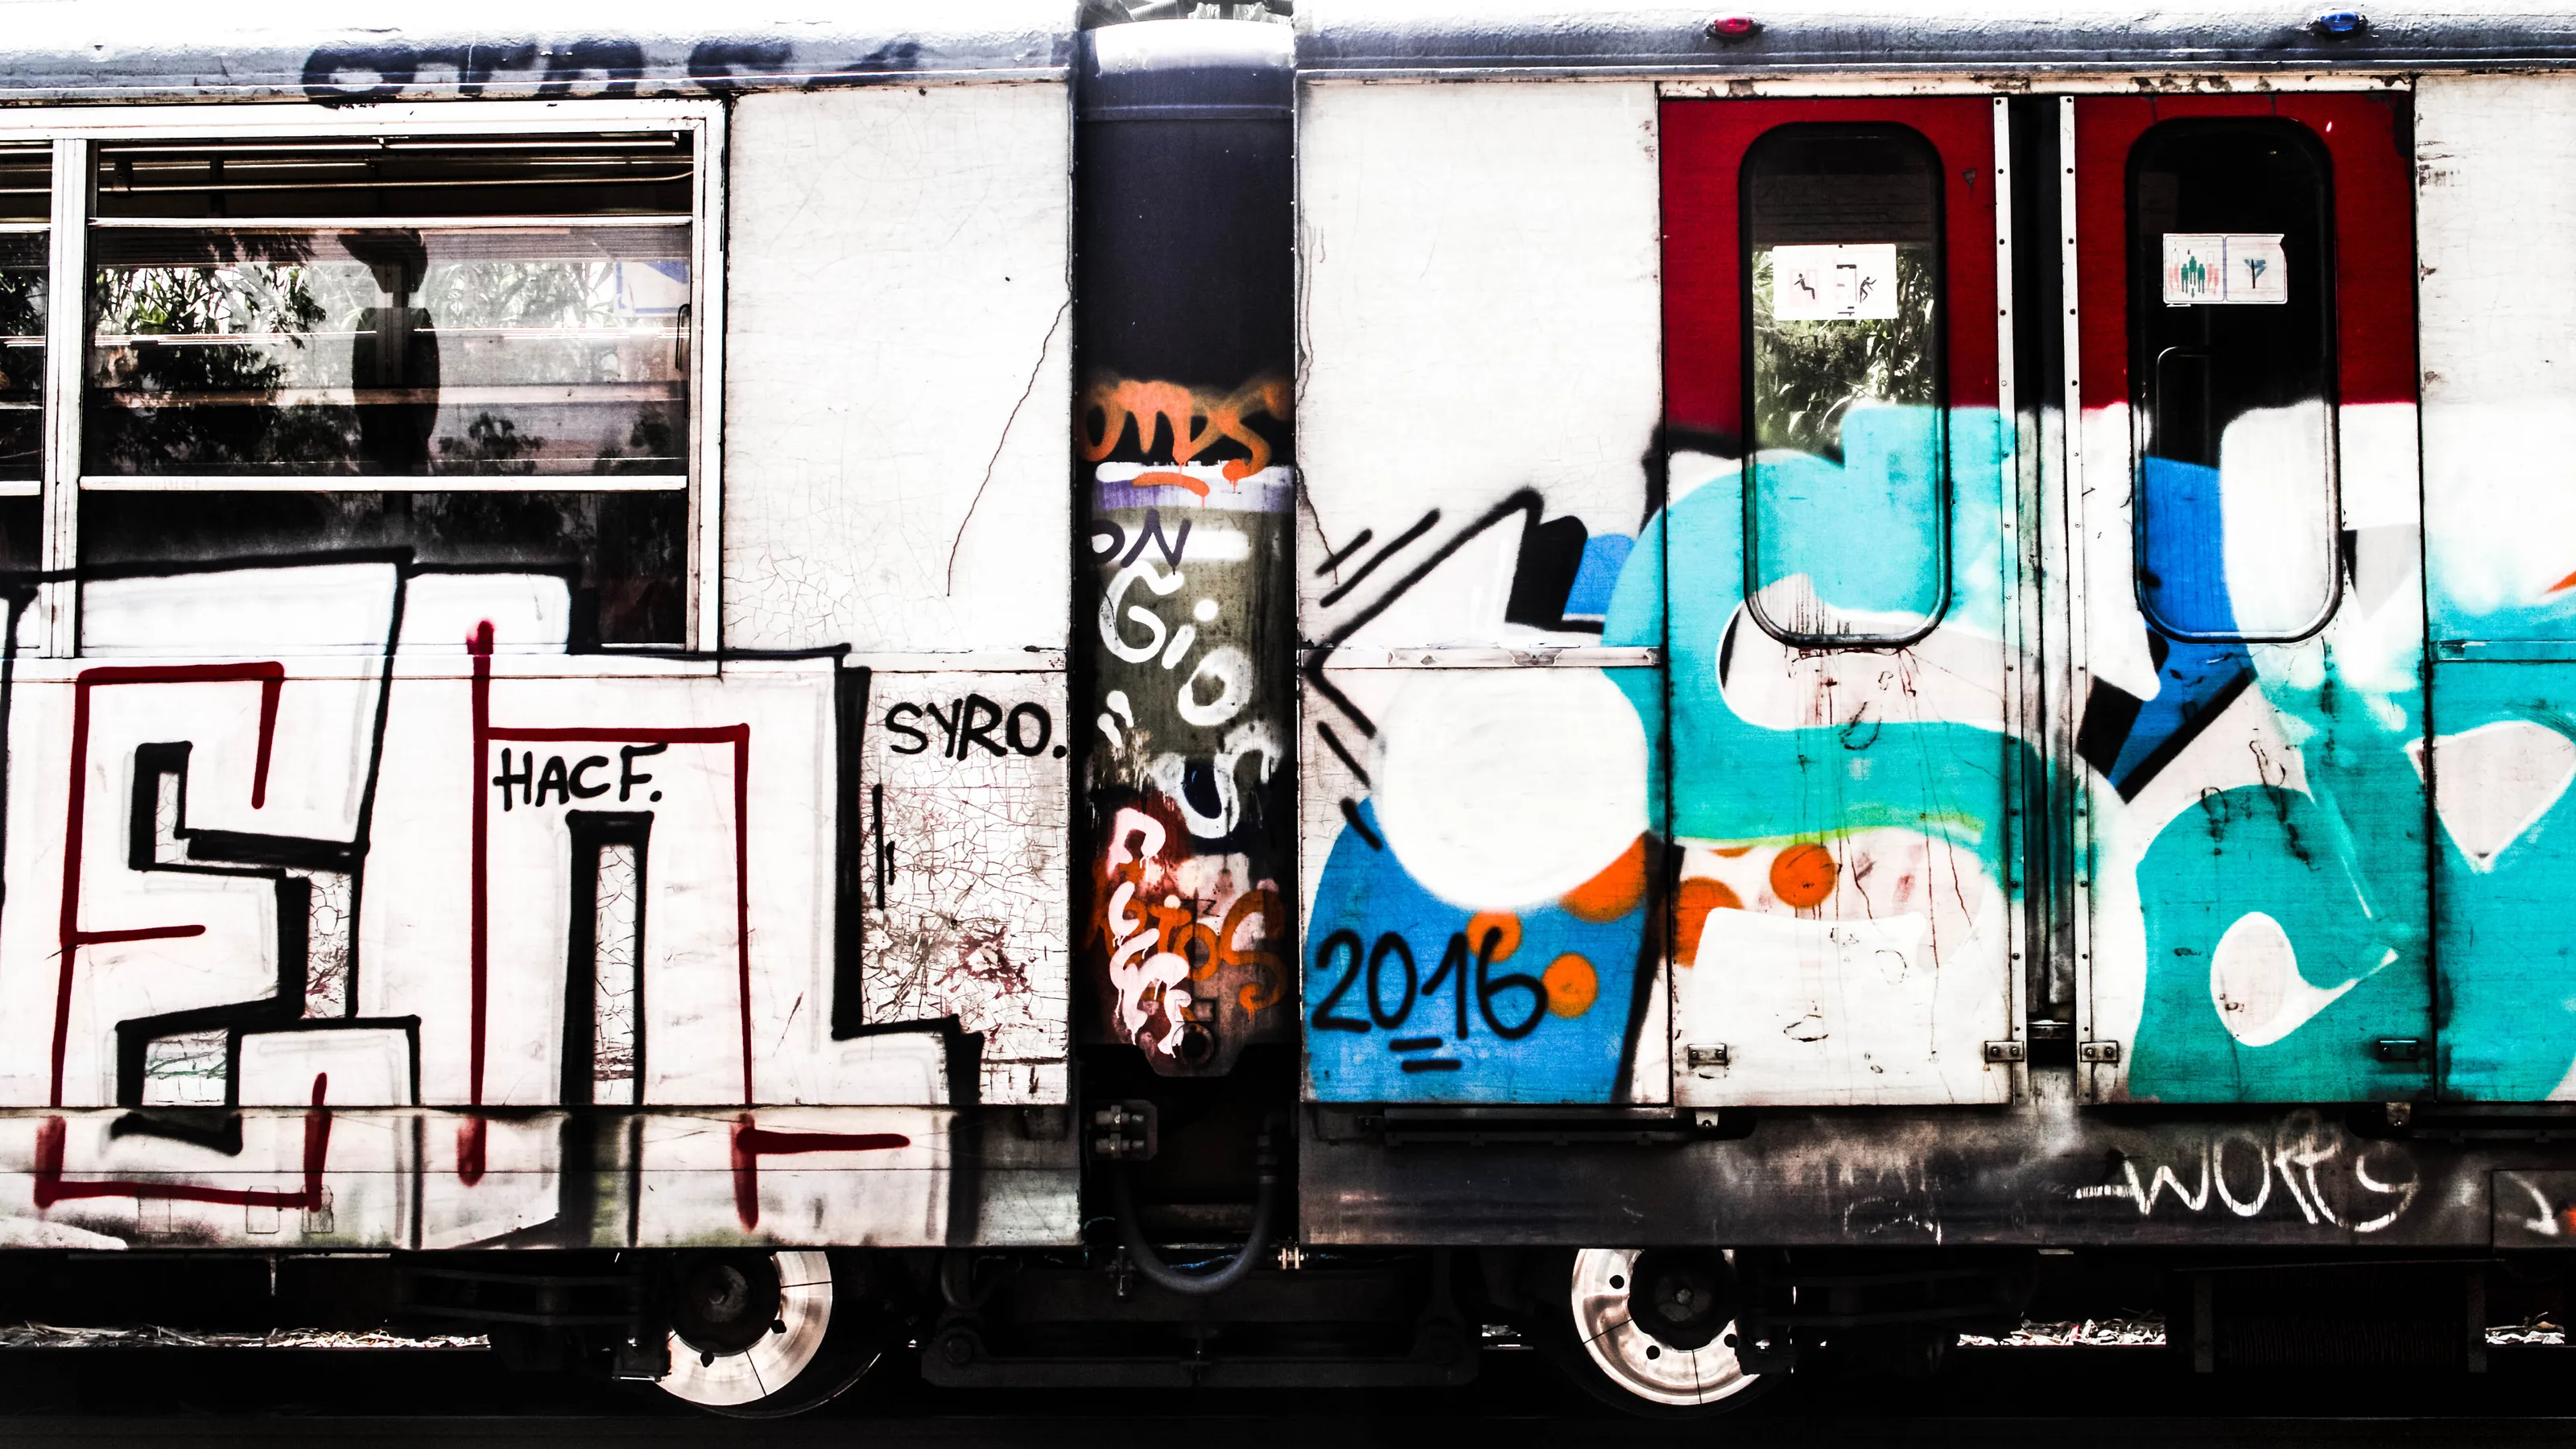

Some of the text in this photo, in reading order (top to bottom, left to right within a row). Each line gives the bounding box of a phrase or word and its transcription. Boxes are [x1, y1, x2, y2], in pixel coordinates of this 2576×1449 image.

[885, 693, 1067, 762] SYRO.
[493, 741, 668, 812] HACF.
[1311, 927, 1549, 1041] 2016
